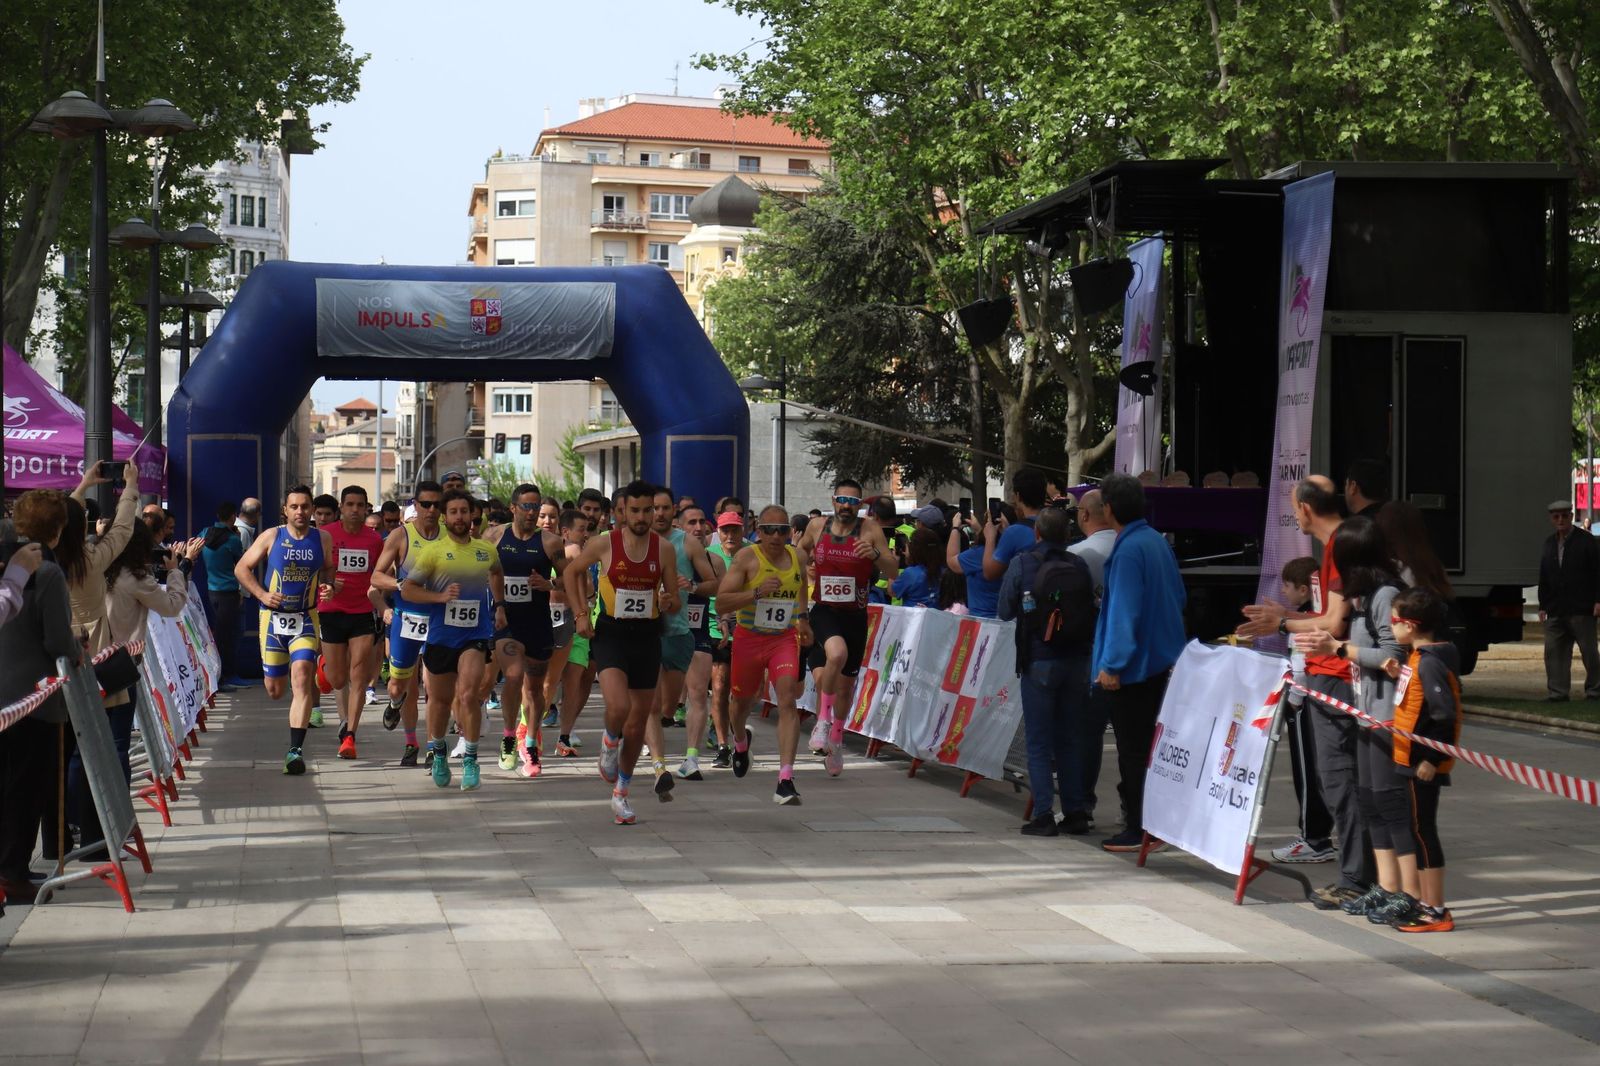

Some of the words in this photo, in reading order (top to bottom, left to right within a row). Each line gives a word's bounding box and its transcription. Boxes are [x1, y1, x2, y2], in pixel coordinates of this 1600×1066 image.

[358, 297, 392, 308] NOS
[358, 311, 448, 330] IMPULSA
[557, 322, 577, 335] de
[284, 549, 313, 560] JESUS
[342, 555, 366, 568] 159
[504, 584, 528, 596] 105
[825, 585, 851, 595] 266
[624, 598, 645, 612] 25
[450, 607, 476, 620] 156
[766, 608, 785, 622] 18
[280, 618, 296, 629] 92
[409, 621, 427, 635] 78
